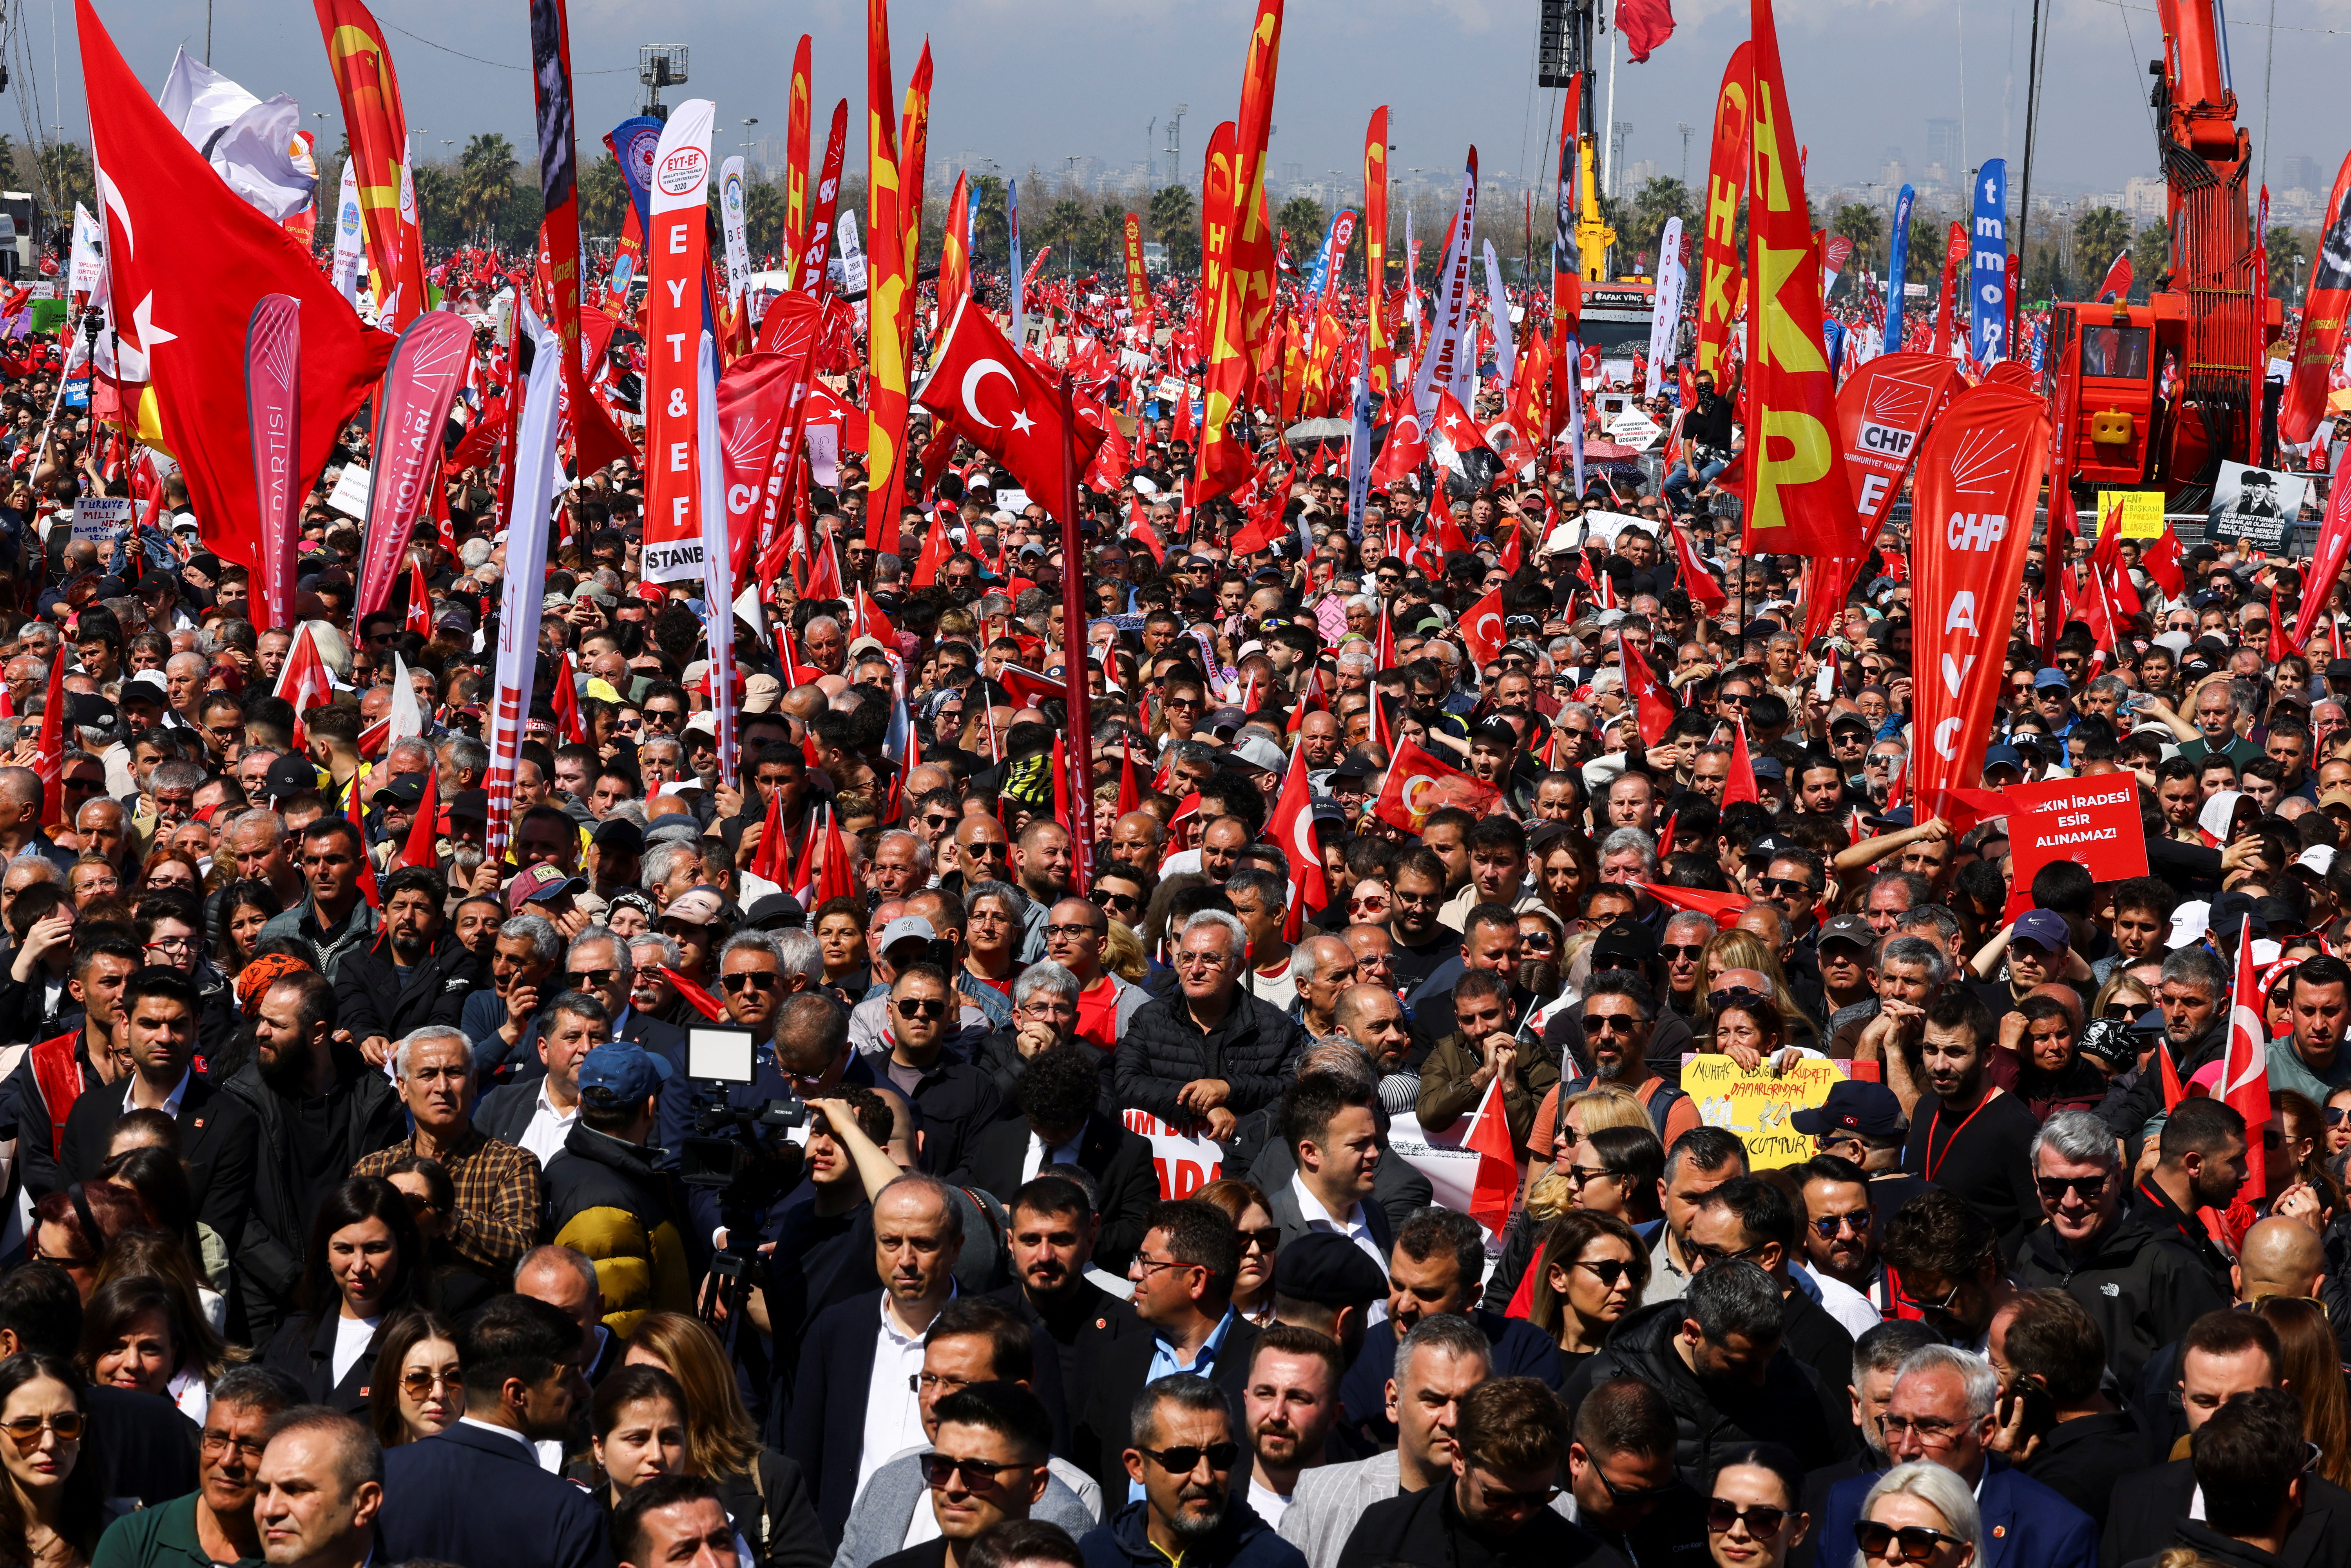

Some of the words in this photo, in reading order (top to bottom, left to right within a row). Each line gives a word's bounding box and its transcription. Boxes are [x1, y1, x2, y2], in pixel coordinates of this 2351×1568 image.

[667, 153, 699, 170] EYT-EF
[1129, 242, 1148, 309] EMEK
[1624, 294, 1643, 304] VİNÇ
[1654, 234, 1674, 368] BORNOVA
[1303, 337, 1329, 412] HKP
[1865, 426, 1913, 453] CHP
[1844, 453, 1883, 467] CUMHURİYET
[2120, 494, 2142, 503] YENİ
[2220, 518, 2252, 527] ÇALIŞANLAR
[2238, 514, 2285, 525] UNUTTURMAYA
[1947, 512, 2007, 551] CHP
[2254, 527, 2282, 536] GENÇLİĞİ
[2012, 733, 2038, 744] NAVY
[2072, 788, 2130, 808] İRADESİ
[2058, 811, 2090, 827] ESİR
[2036, 827, 2117, 847] ALINAMAZ!
[1791, 1068, 1831, 1085] KUDRET
